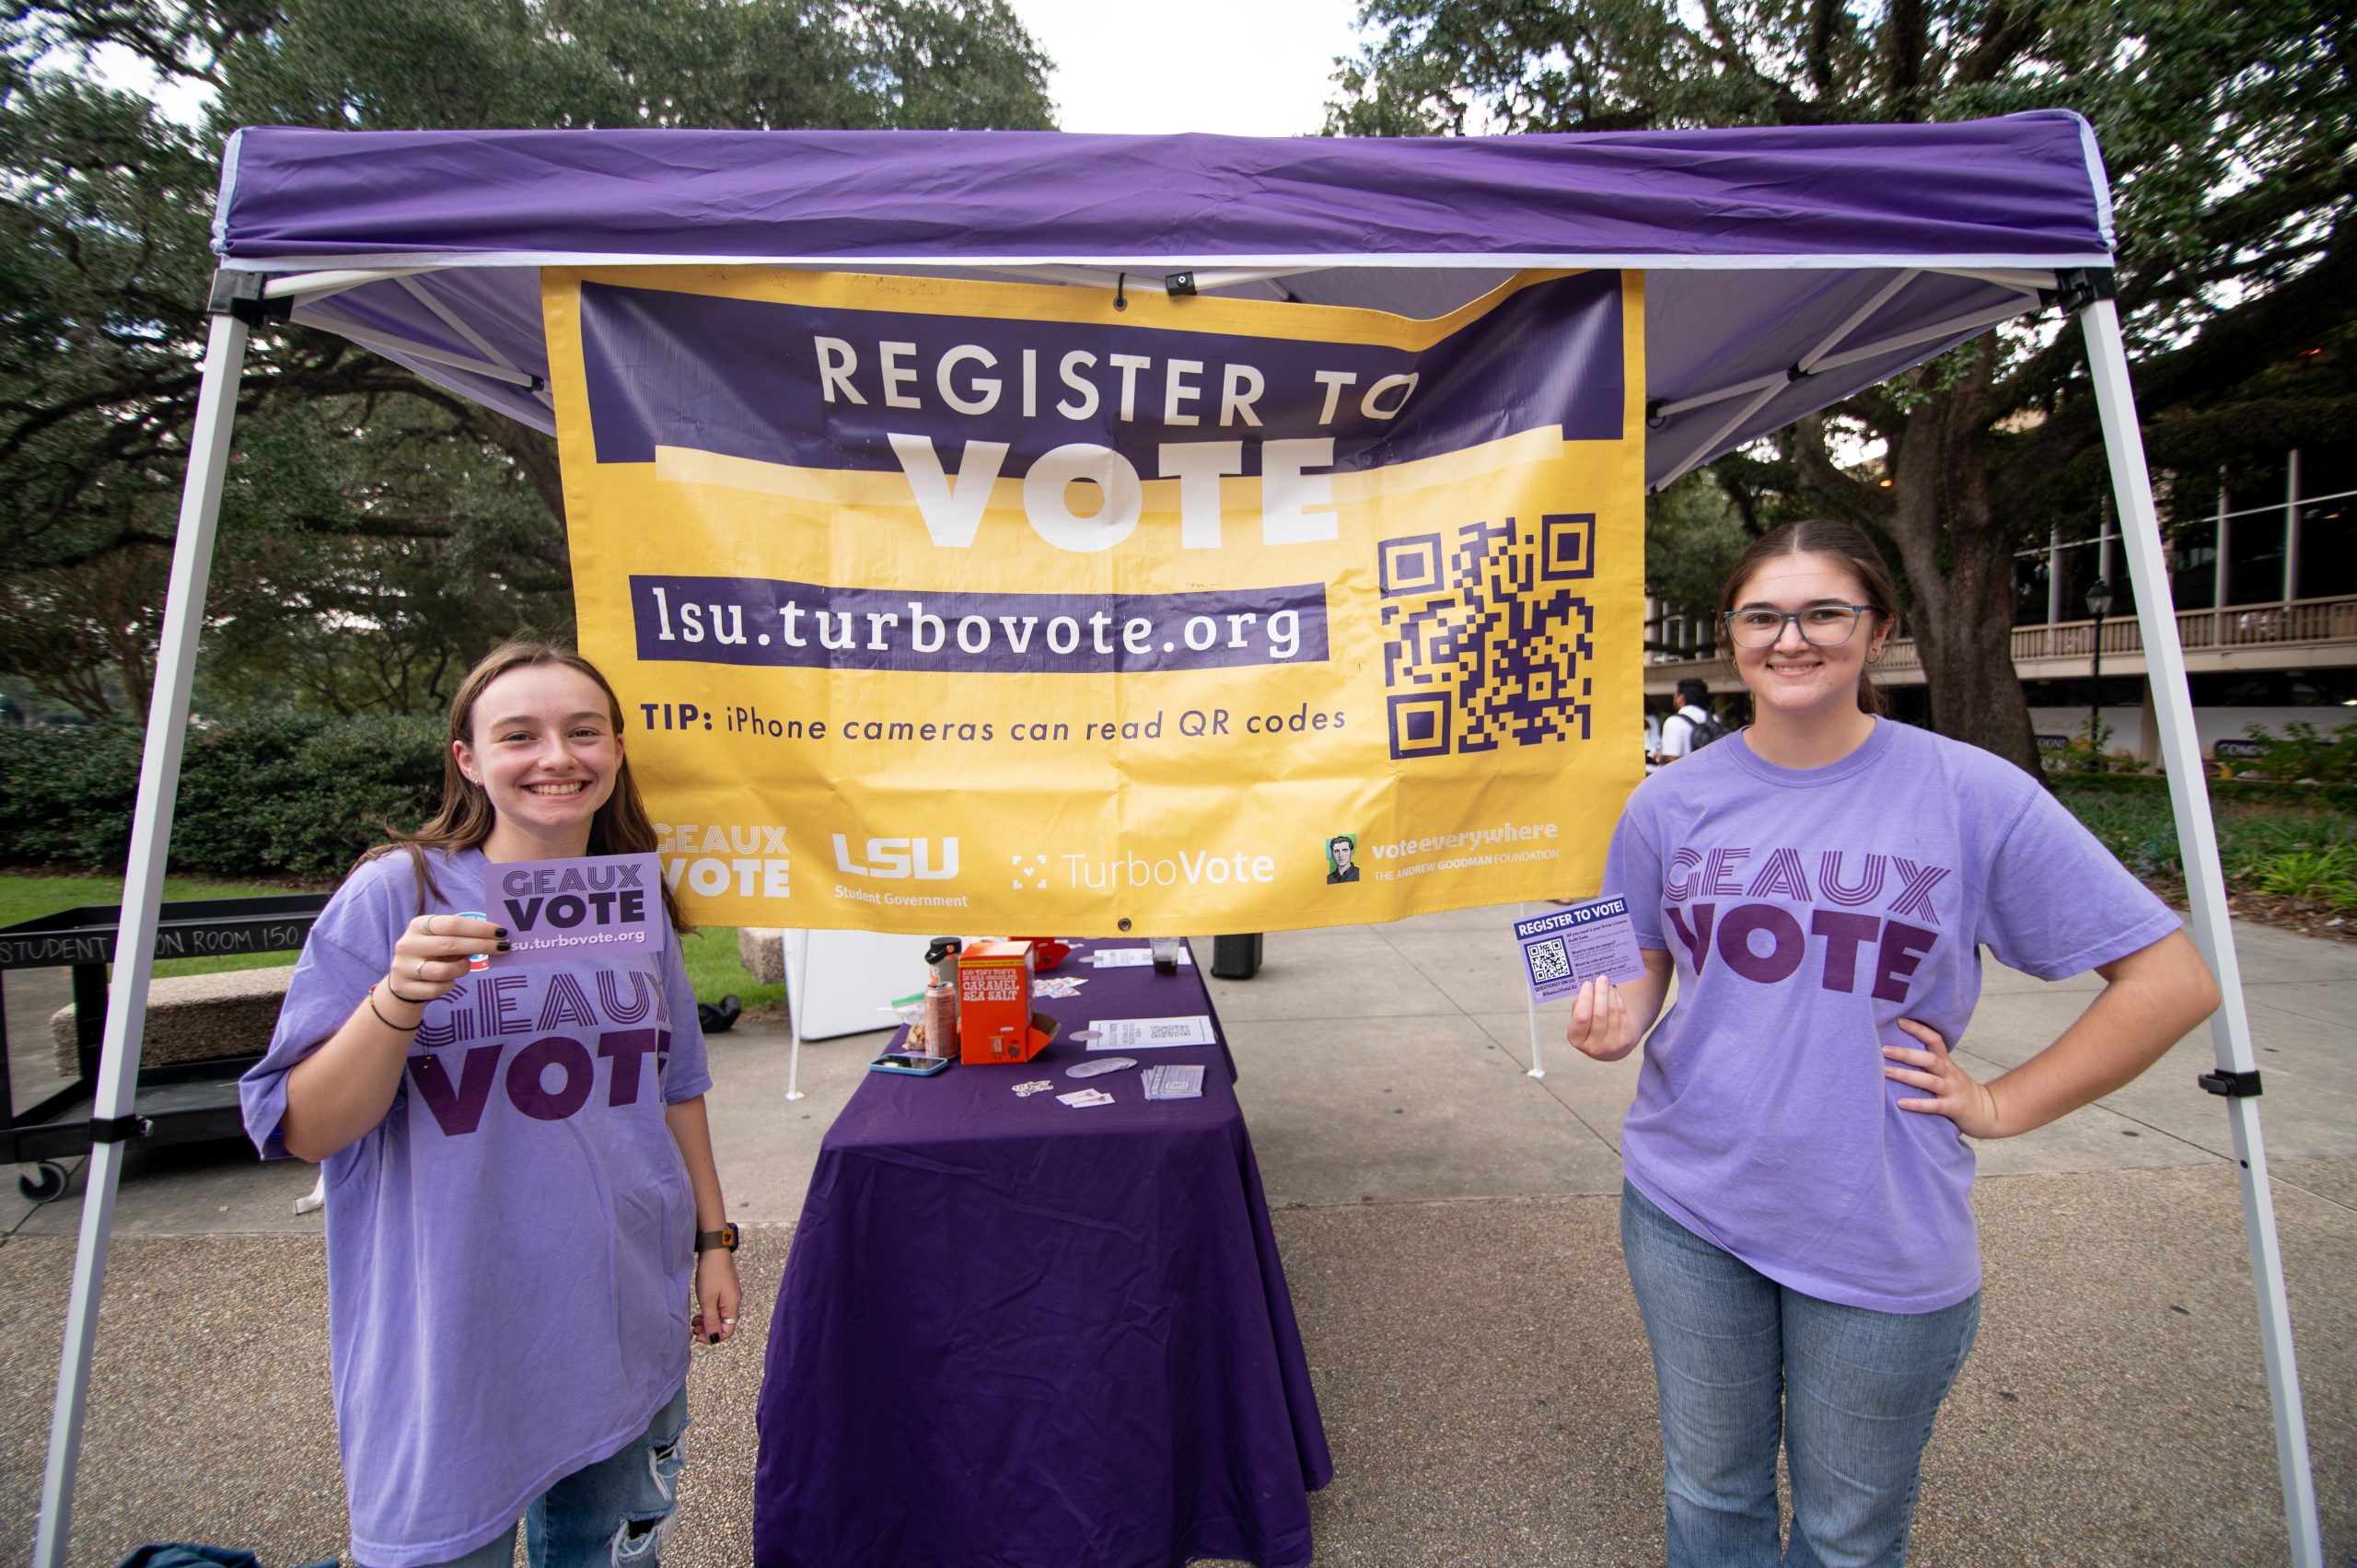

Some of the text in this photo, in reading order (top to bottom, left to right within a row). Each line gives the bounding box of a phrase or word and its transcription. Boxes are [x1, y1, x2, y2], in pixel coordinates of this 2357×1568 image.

[814, 335, 1419, 427] REGISTER TO
[888, 432, 1339, 553] VOTE
[652, 587, 1301, 659] lsu.turbovote.org
[640, 703, 1346, 741] TIP: iPhone cameras can read QR codes
[832, 832, 959, 880] LSU
[1372, 821, 1559, 860] voteeverywhere
[502, 864, 644, 897] GEAUX
[1061, 850, 1275, 889] TurboVote
[1374, 849, 1560, 882] THE ANDREW GOODMAN FOUNDATION
[834, 885, 969, 907] Student Government
[1663, 847, 1952, 925] GEAUX
[504, 889, 645, 932] VOTE
[1518, 900, 1625, 937] REGISTER TO VOTE!
[0, 937, 109, 963] STUDENT
[193, 930, 254, 950] ROOM
[263, 926, 299, 946] 150
[507, 931, 645, 952] su.turbovote.org
[1665, 902, 1939, 1004] VOTE
[962, 980, 1020, 991] CARAMEL
[963, 990, 1017, 1001] SEA SALT
